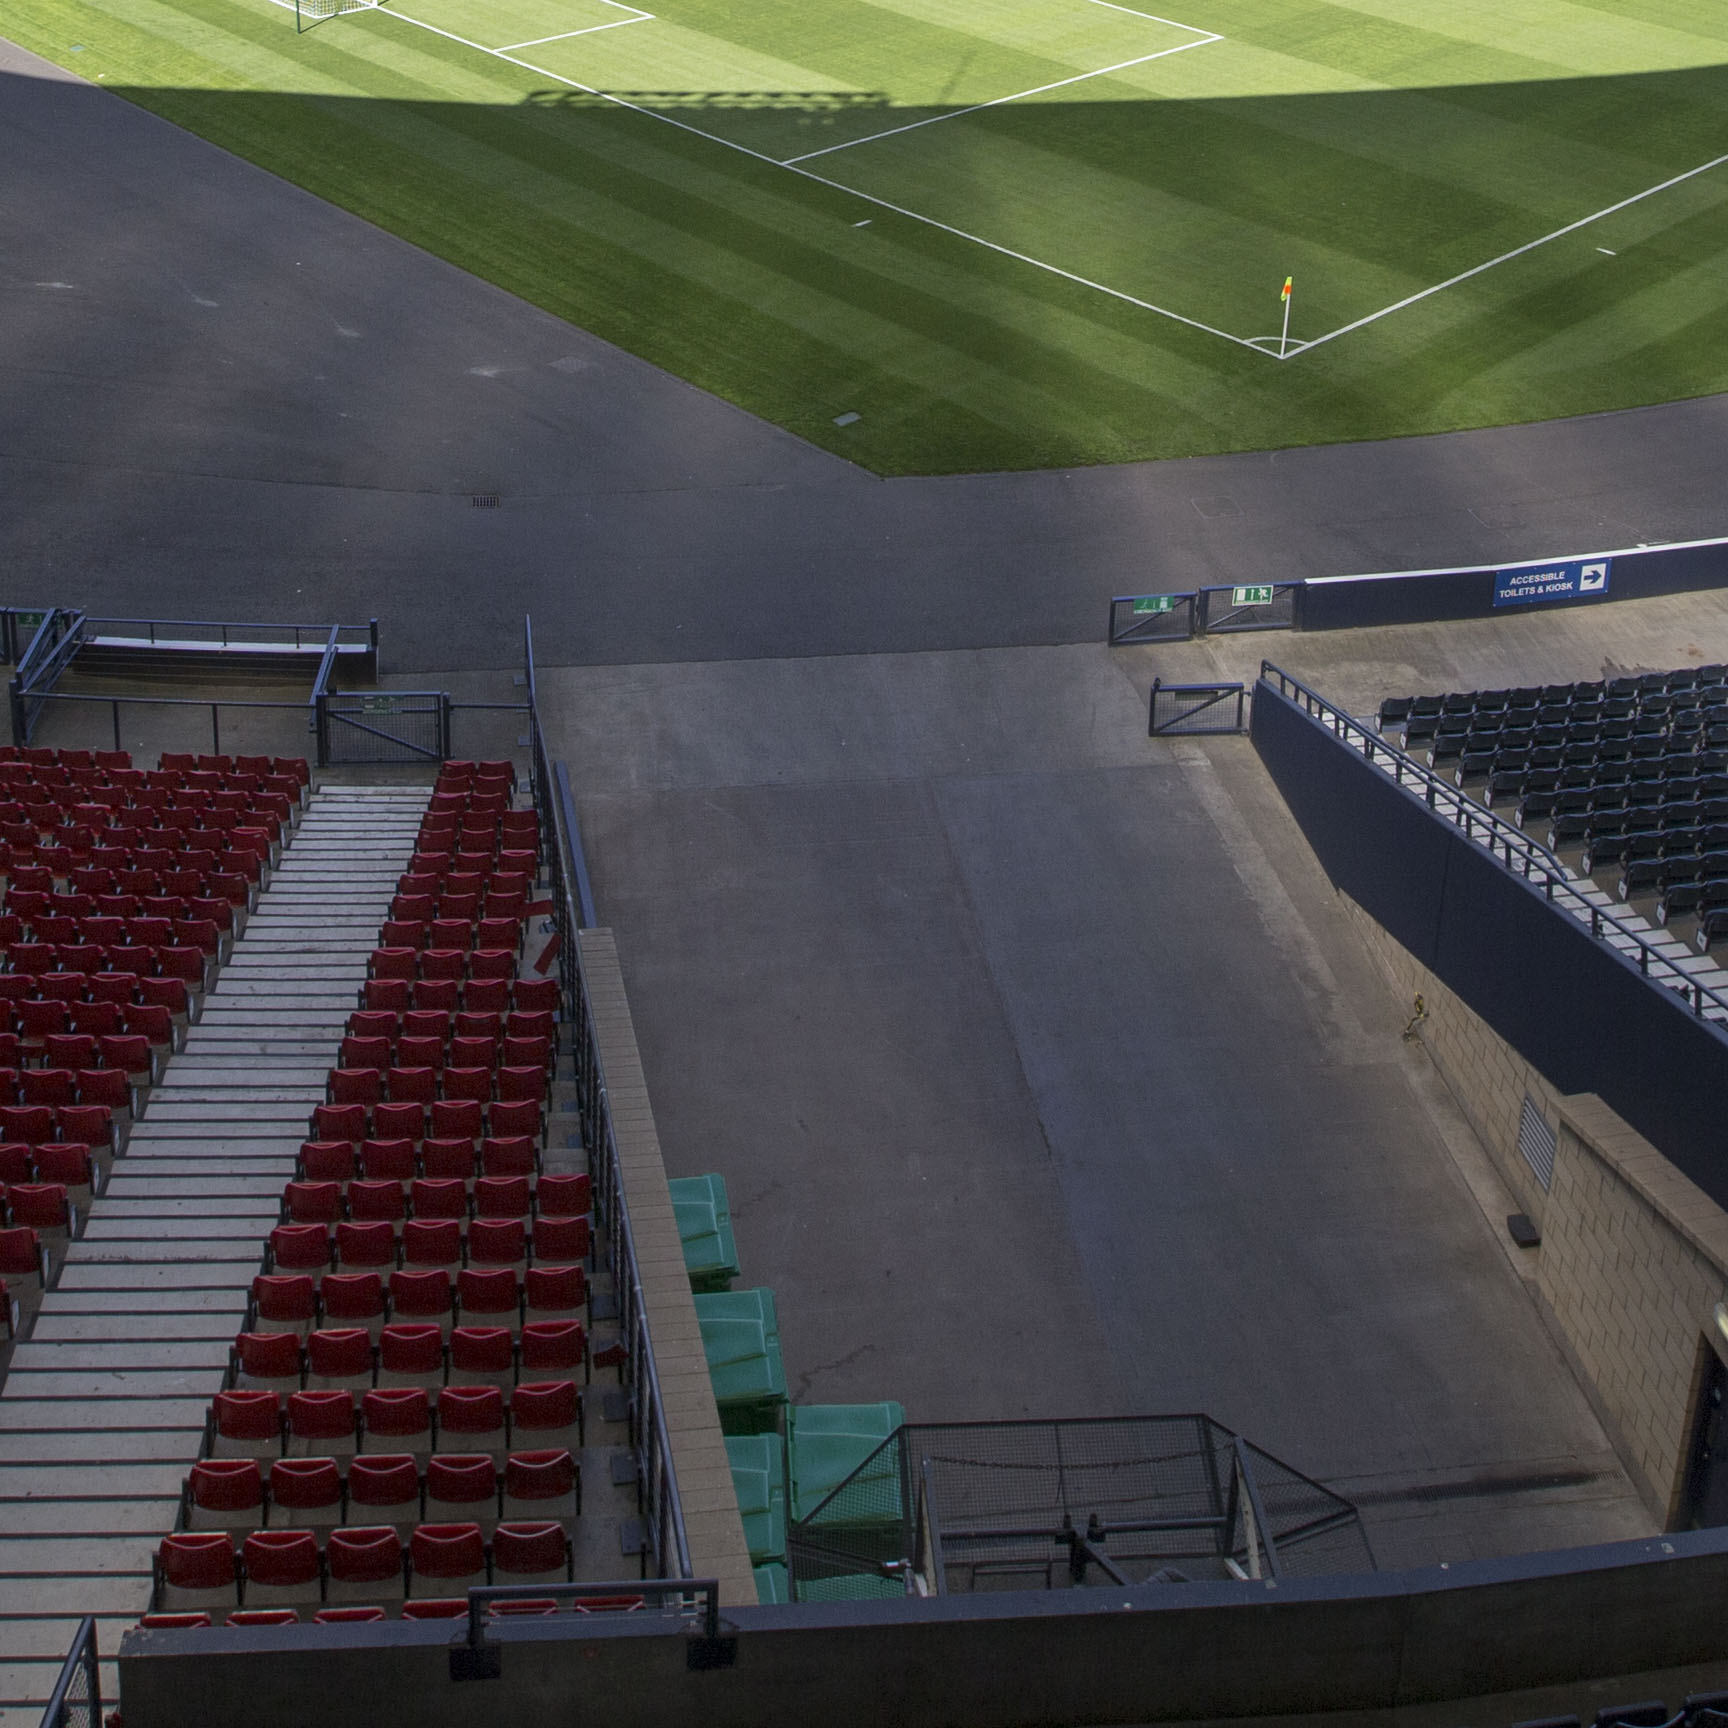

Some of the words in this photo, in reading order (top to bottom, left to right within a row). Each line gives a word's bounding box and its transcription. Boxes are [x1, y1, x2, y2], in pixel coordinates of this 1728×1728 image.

[1510, 571, 1565, 585] ACCESSIBLE
[1500, 587, 1536, 598] TOILETS
[1545, 582, 1574, 593] KIOSK
